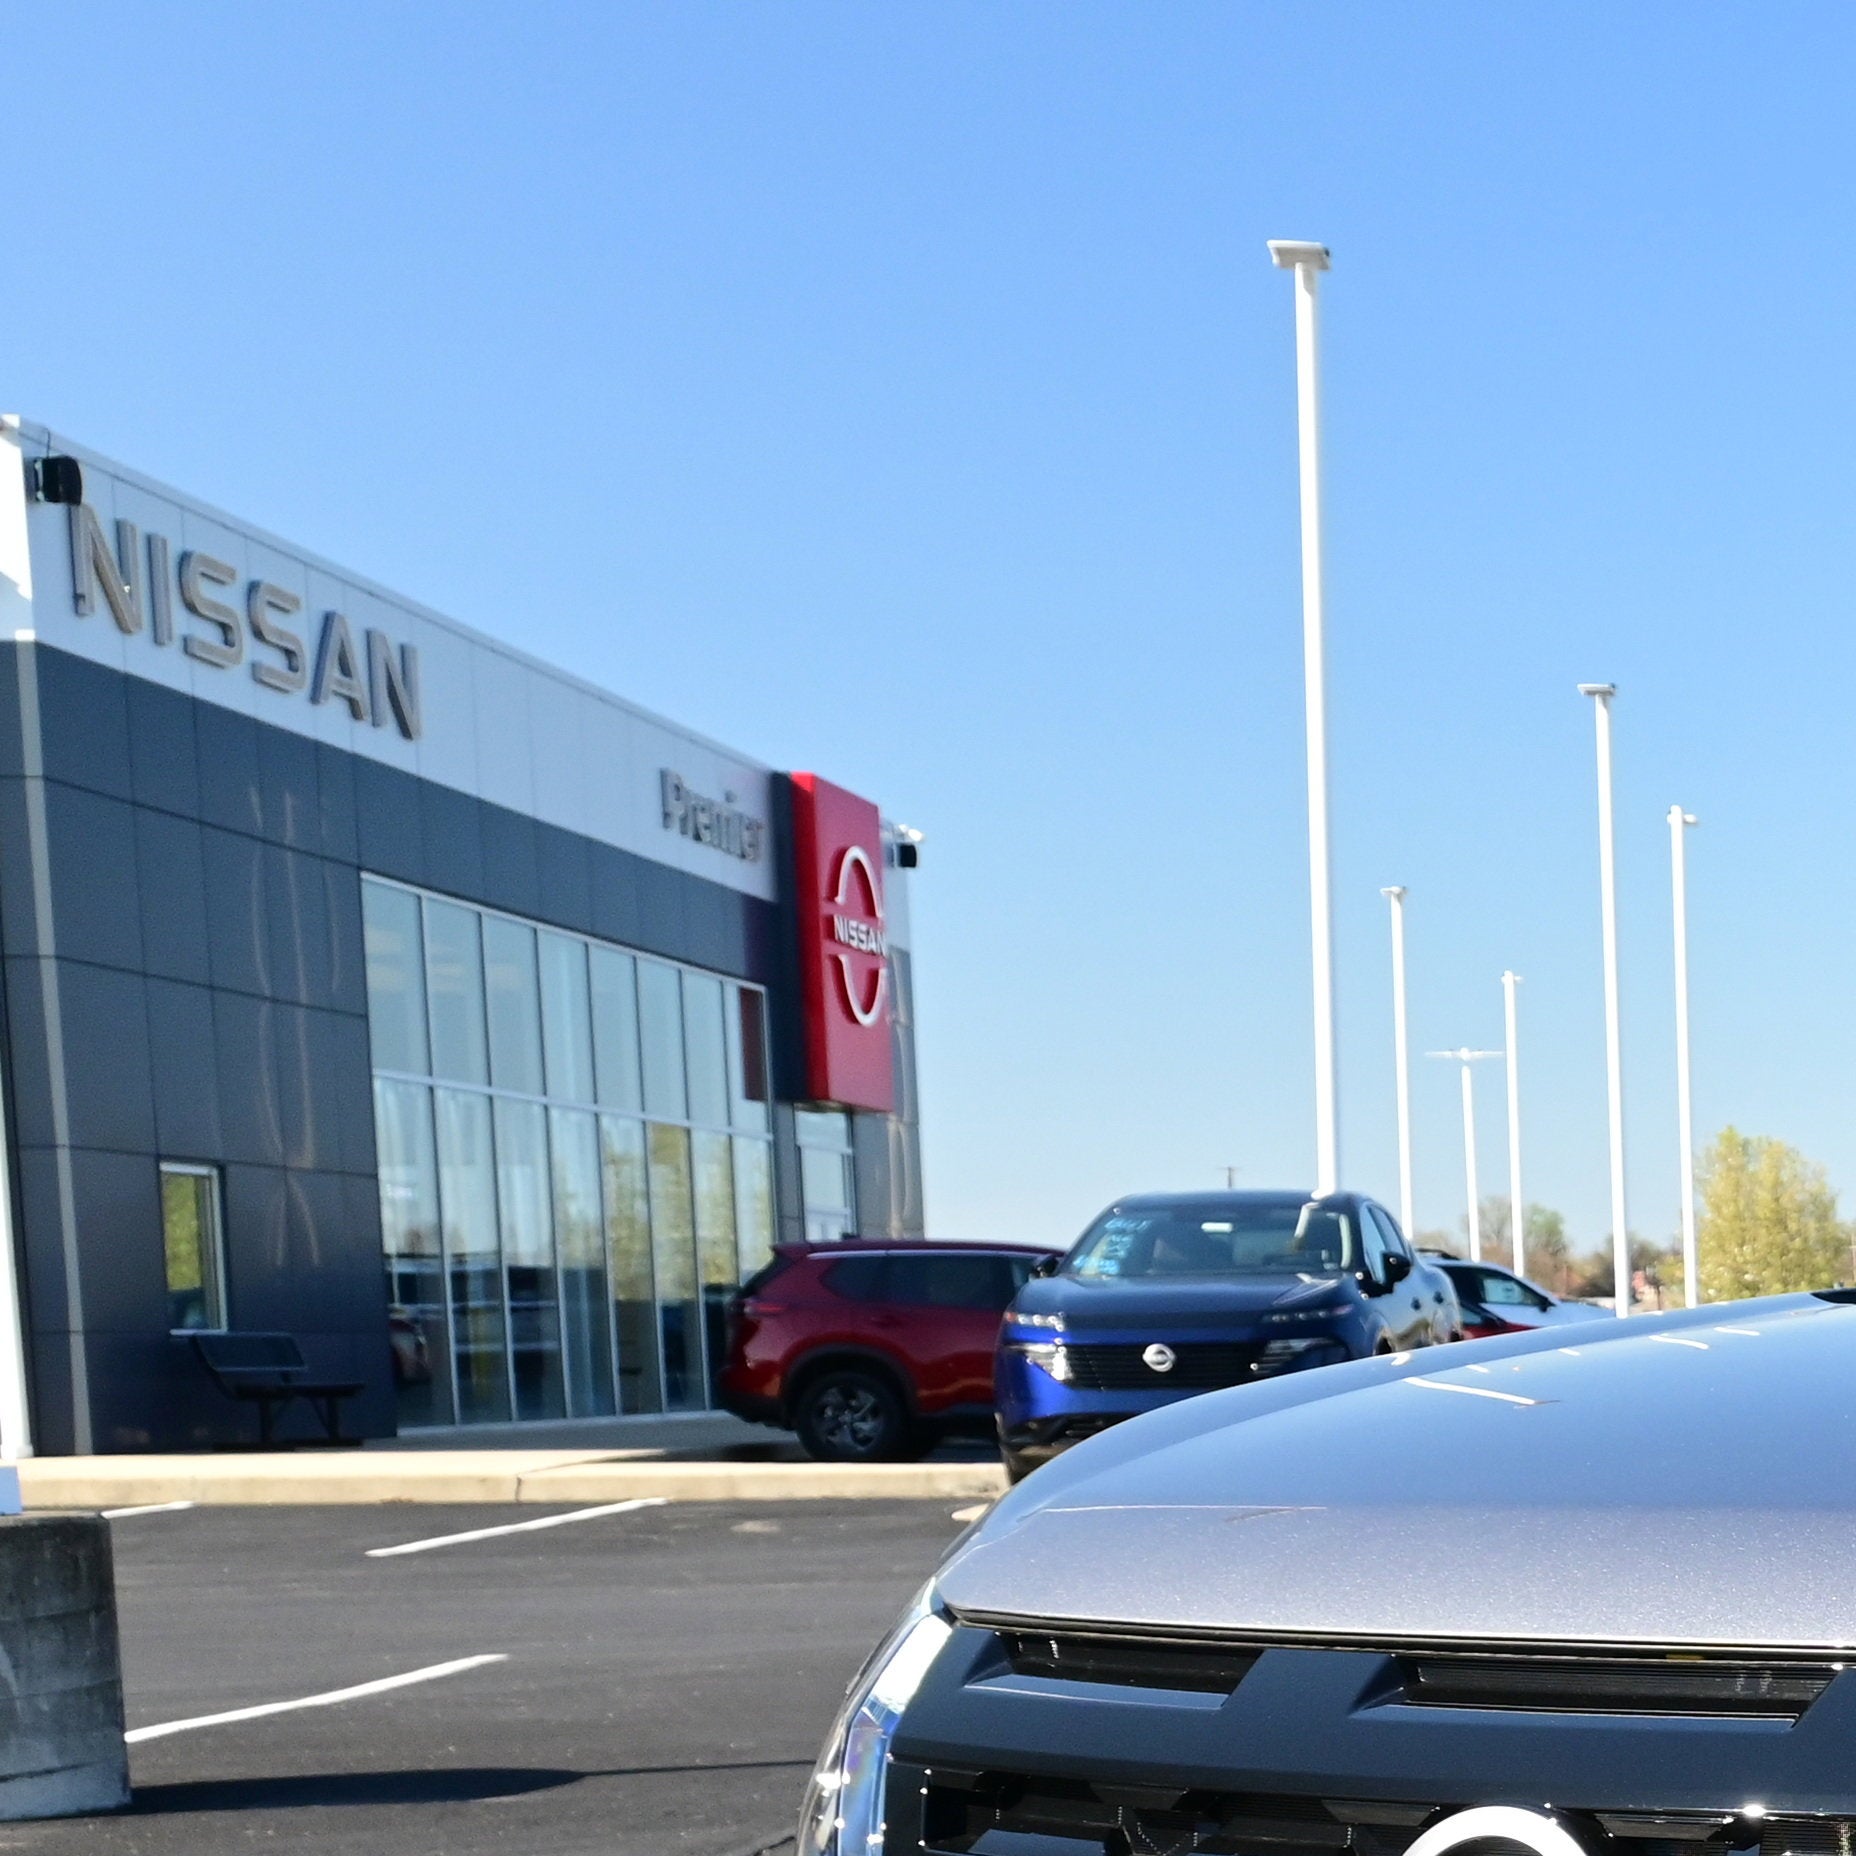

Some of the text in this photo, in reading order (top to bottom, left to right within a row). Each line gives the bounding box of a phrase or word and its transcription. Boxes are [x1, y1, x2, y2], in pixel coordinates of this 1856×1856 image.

[68, 502, 422, 741] NISSAN
[659, 770, 764, 864] Premier
[834, 914, 888, 960] NISSAN
